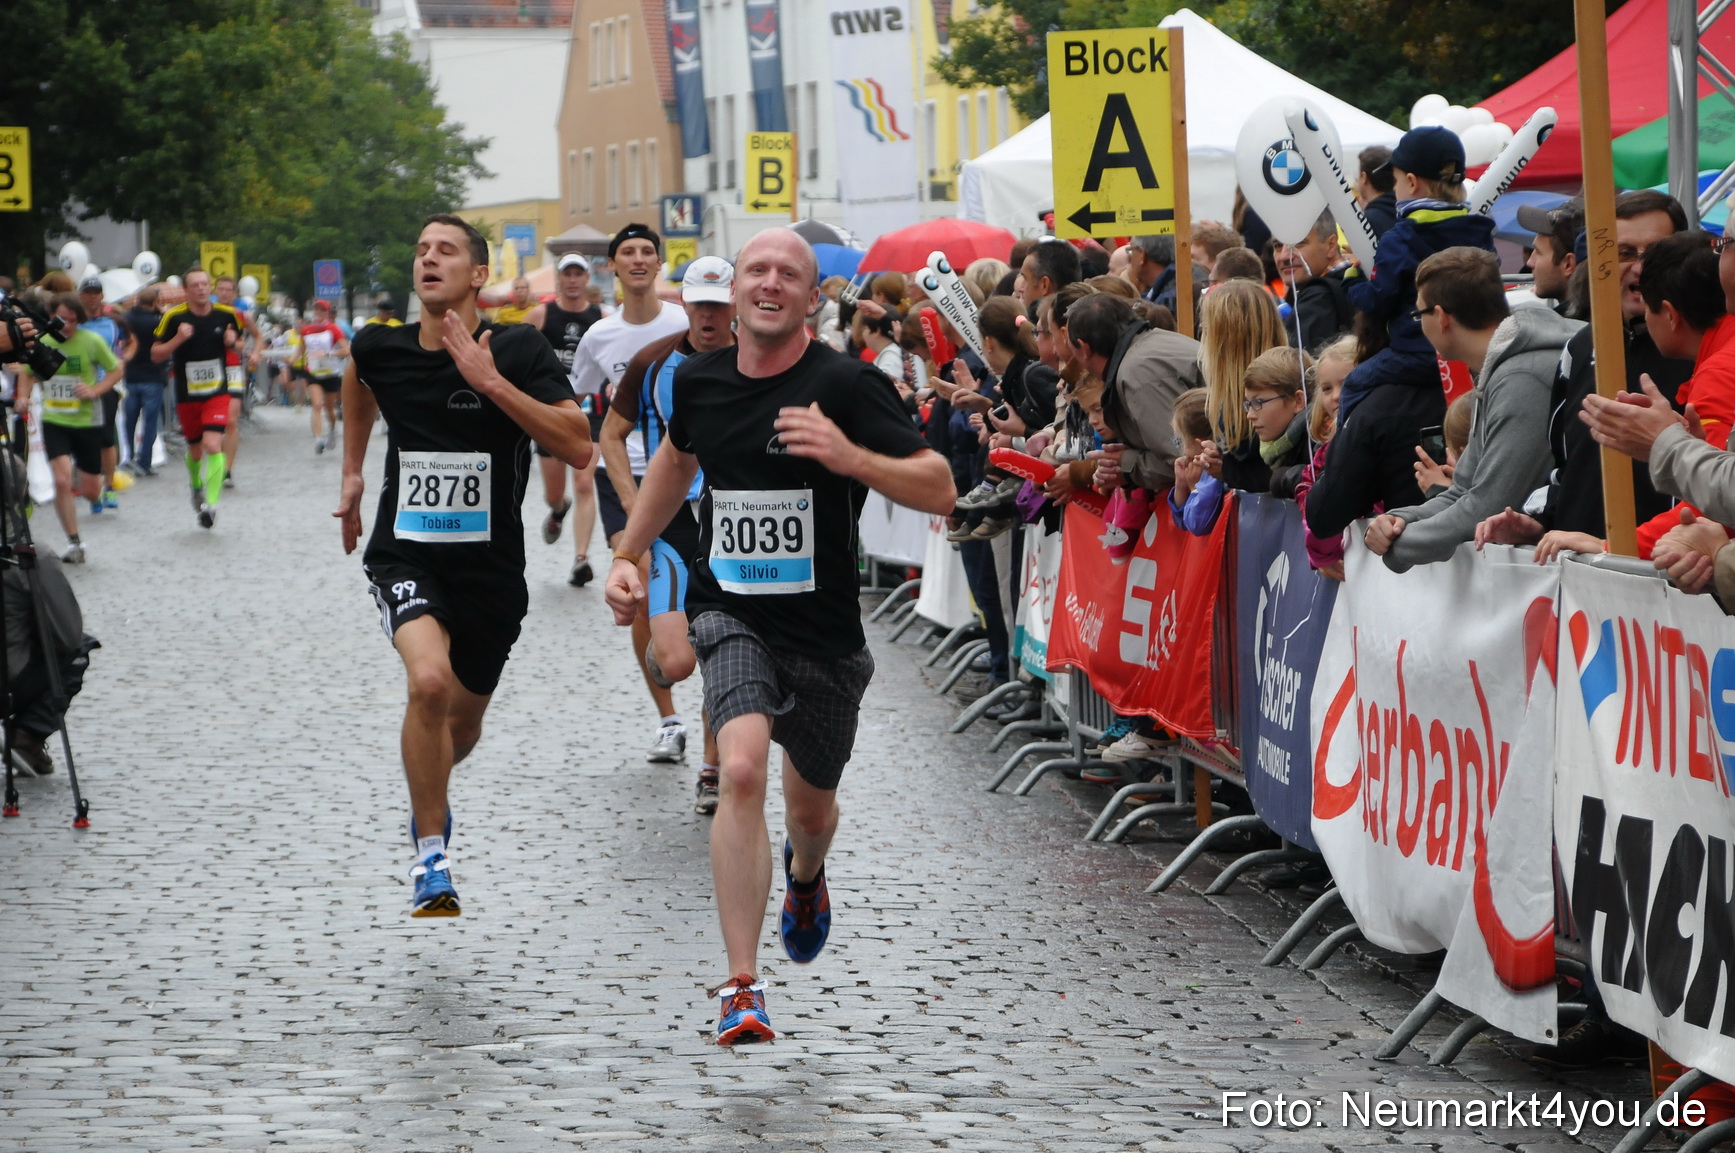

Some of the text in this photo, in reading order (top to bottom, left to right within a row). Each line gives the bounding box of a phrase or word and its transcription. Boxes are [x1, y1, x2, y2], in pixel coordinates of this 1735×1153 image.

[1064, 37, 1169, 76] Block
[751, 136, 793, 150] Block
[1081, 93, 1160, 192] A
[759, 157, 784, 195] B
[1592, 227, 1615, 256] NR
[209, 256, 226, 279] C
[193, 367, 215, 381] 336
[402, 461, 472, 471] PARTL Neumarkt
[407, 474, 481, 507] 2878
[714, 500, 793, 511] PARTL Neumarkt
[421, 516, 461, 529] Tobias
[720, 515, 803, 554] 3039
[740, 564, 779, 579] Silvio
[391, 580, 417, 600] 99
